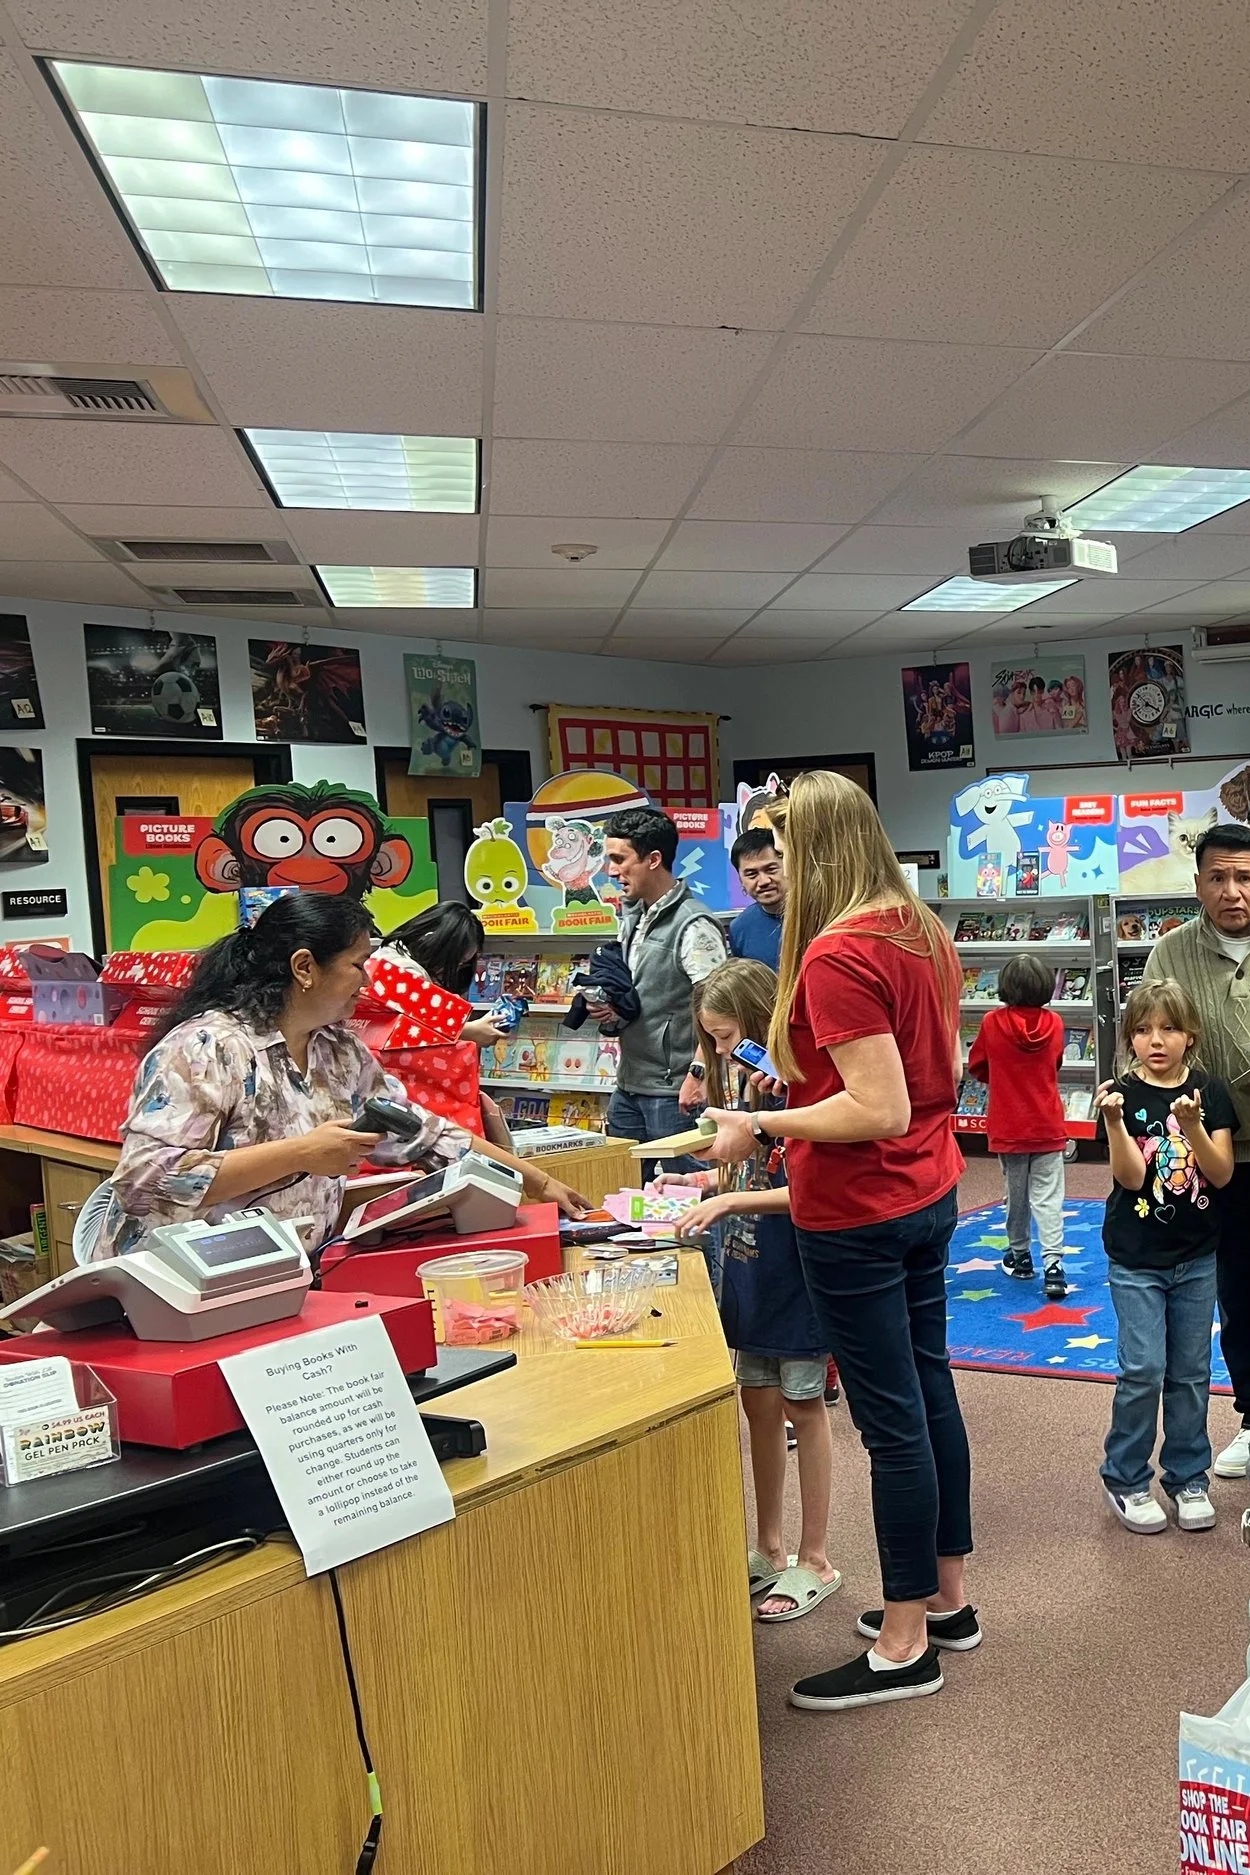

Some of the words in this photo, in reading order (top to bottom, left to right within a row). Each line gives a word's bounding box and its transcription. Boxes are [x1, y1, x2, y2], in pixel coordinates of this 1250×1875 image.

[928, 750, 954, 759] KPOP
[1130, 799, 1149, 808] FUN
[1149, 798, 1177, 806] FACTS
[673, 813, 709, 821] PICTURE
[676, 821, 706, 829] BOOKS
[140, 824, 196, 834] PICTURE
[145, 833, 192, 843] BOOKS
[905, 870, 912, 880] 2
[9, 894, 62, 906] RESOURCE
[481, 919, 505, 927] OOK
[505, 917, 530, 926] FAIR
[558, 918, 588, 928] BOOK
[588, 915, 612, 925] FAIR
[344, 1018, 372, 1029] UPPLY
[518, 1100, 548, 1119] GOA
[970, 1118, 987, 1130] SC
[535, 1140, 584, 1153] BOOKMARKS
[265, 1361, 301, 1377] Buying
[302, 1352, 334, 1366] Books
[335, 1343, 358, 1356] With
[302, 1364, 334, 1381] Cash?
[265, 1400, 299, 1414] Please
[299, 1390, 326, 1404] Note:
[326, 1384, 345, 1396] The
[345, 1375, 370, 1389] book
[370, 1371, 385, 1381] fair
[279, 1407, 318, 1425] balance
[319, 1395, 354, 1412] amount
[355, 1388, 371, 1400] will
[372, 1385, 384, 1394] be
[74, 1416, 84, 1424] US
[85, 1411, 105, 1421] EACH
[292, 1417, 333, 1436] rounded
[334, 1412, 347, 1422] up
[347, 1406, 361, 1418] for
[362, 1401, 384, 1413] cash
[20, 1421, 106, 1451] RAINBOW
[288, 1428, 342, 1453] purchases,
[342, 1425, 353, 1433] as
[355, 1420, 368, 1428] we
[368, 1414, 384, 1424] will
[384, 1410, 396, 1419] be
[25, 1449, 46, 1461] GEL
[48, 1443, 69, 1455] PEN
[72, 1436, 100, 1449] PACK
[297, 1450, 326, 1464] using
[326, 1435, 365, 1454] quarters
[365, 1427, 384, 1440] only
[384, 1423, 398, 1433] for
[305, 1459, 344, 1476] change.
[344, 1443, 384, 1462] Students
[384, 1437, 401, 1447] can
[316, 1471, 344, 1487] either
[345, 1461, 374, 1477] round
[373, 1456, 386, 1467] up
[386, 1451, 401, 1461] the
[307, 1486, 344, 1505] amount
[345, 1482, 355, 1491] or
[356, 1470, 389, 1487] choose
[389, 1467, 399, 1475] to
[400, 1459, 418, 1470] take
[317, 1509, 325, 1517] a
[325, 1496, 361, 1513] lollipop
[361, 1483, 394, 1501] instead
[395, 1477, 405, 1488] of
[405, 1473, 419, 1484] the
[333, 1504, 379, 1526] remaining
[379, 1492, 416, 1508] balance.
[1181, 1788, 1207, 1811] SHOP
[1207, 1792, 1230, 1815] THE
[1180, 1809, 1210, 1836] OOK
[1211, 1815, 1248, 1842] FAIR
